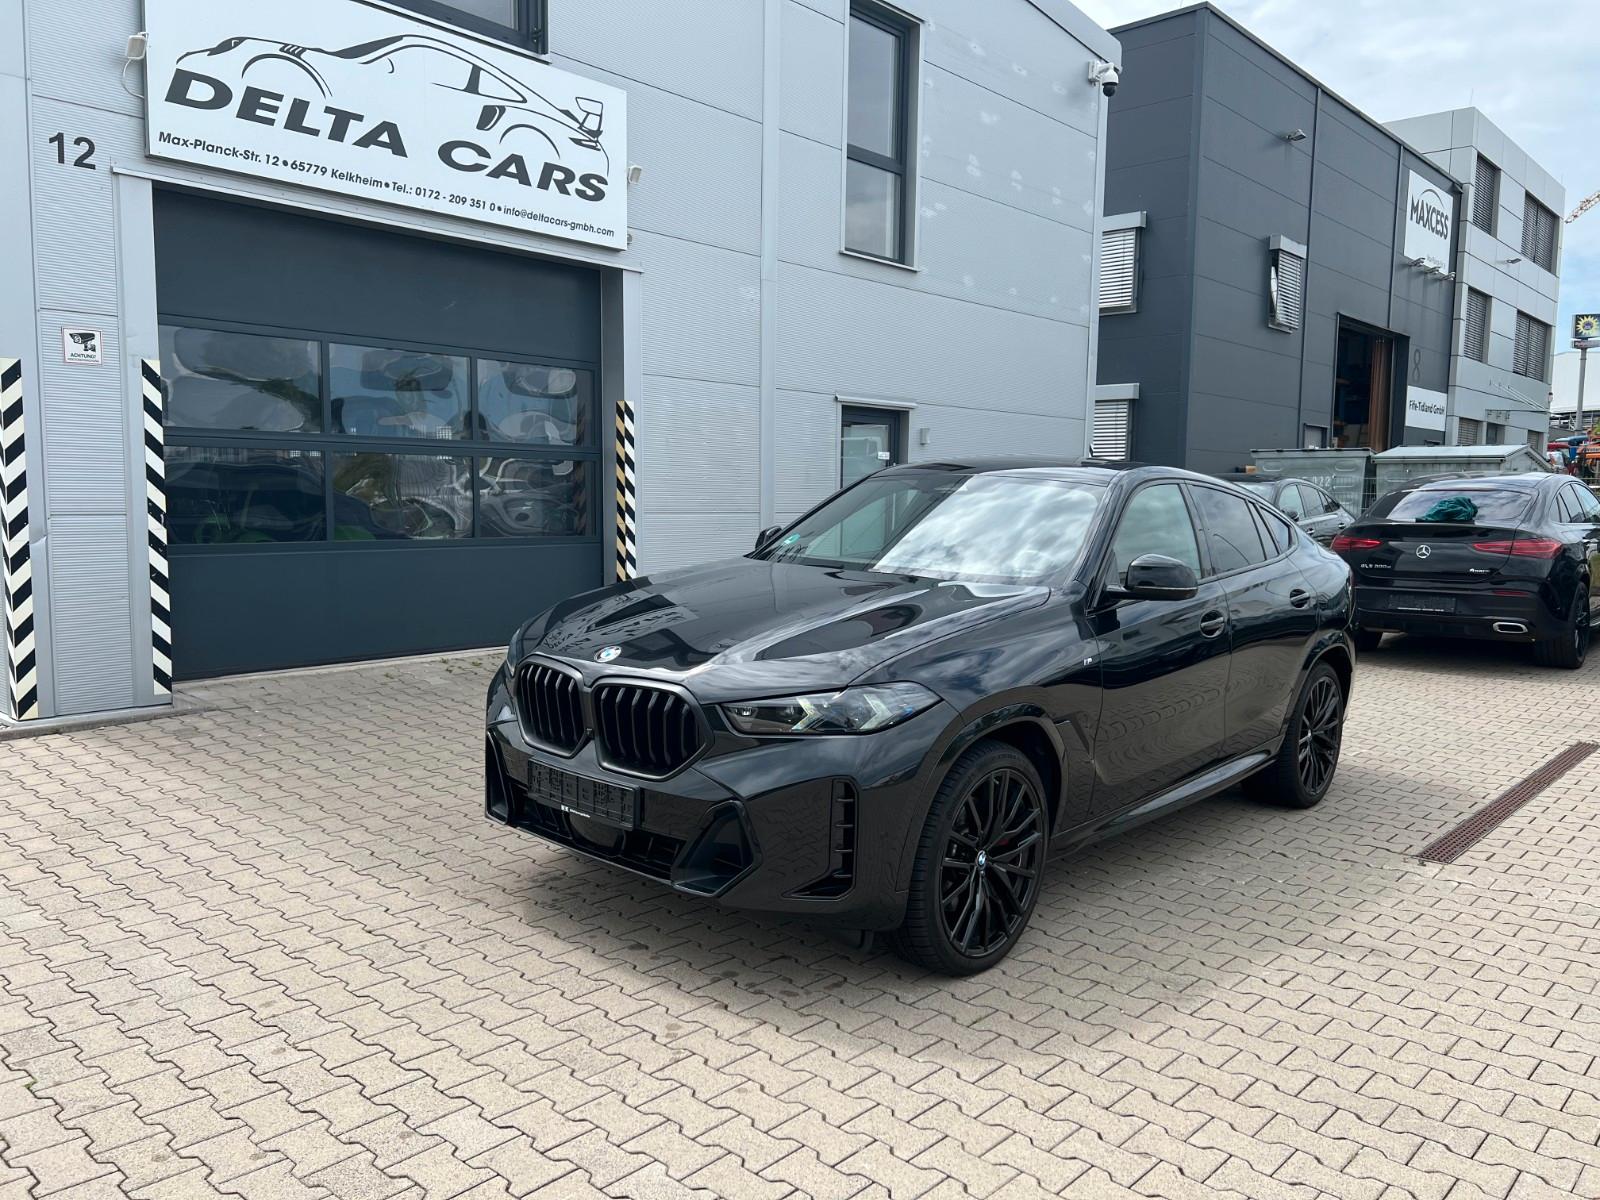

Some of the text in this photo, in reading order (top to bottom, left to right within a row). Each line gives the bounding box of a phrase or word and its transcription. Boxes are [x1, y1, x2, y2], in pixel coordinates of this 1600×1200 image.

[48, 132, 96, 170] 12
[164, 68, 609, 202] DELTA CARS
[158, 131, 262, 163] Max-Planck-Str.
[265, 154, 280, 167] 12
[290, 160, 328, 176] 65779
[330, 168, 384, 188] Kelkheim
[391, 181, 413, 195] Tel.:
[415, 186, 440, 200] 0172
[449, 193, 467, 206] 209
[469, 198, 487, 210] 351
[489, 202, 496, 212] 0
[503, 204, 615, 238] info@deltacars-gmbh.com
[1410, 194, 1449, 240] MAXCESS
[1412, 348, 1421, 383] 8
